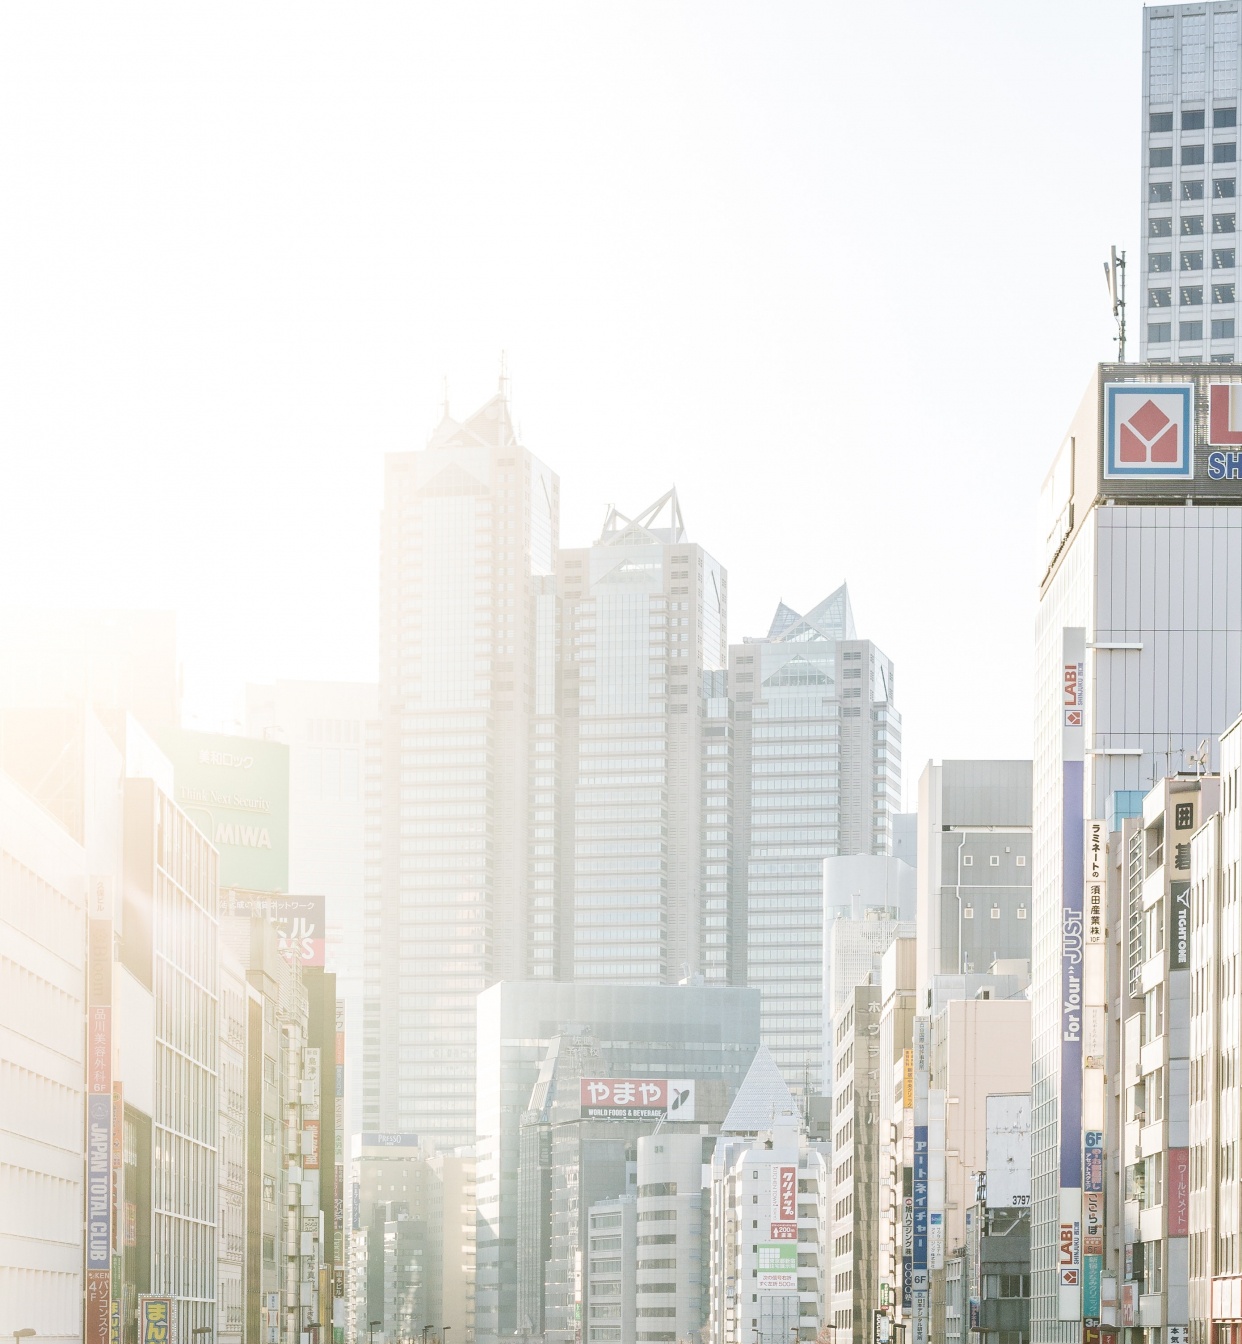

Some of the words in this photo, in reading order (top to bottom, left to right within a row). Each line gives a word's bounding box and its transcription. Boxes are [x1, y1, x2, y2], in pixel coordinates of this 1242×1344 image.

[1064, 665, 1077, 706] LABI
[181, 785, 208, 802] Think
[210, 789, 232, 805] Next
[234, 794, 271, 812] Security
[215, 822, 272, 849] MIWA
[1091, 824, 1101, 878] ラミネートの
[1063, 907, 1082, 964] JUST
[1064, 975, 1080, 1014] Your
[94, 1008, 106, 1082] 品川美容外科
[1064, 1014, 1080, 1042] For
[93, 1084, 106, 1092] 6F
[587, 1082, 662, 1105] やまや
[588, 1108, 607, 1116] WORLD
[608, 1109, 627, 1117] FOODS
[633, 1109, 662, 1117] BEVERAGE
[90, 1123, 108, 1173] JAPAN
[1085, 1132, 1102, 1147] 6F
[90, 1175, 107, 1220] TOTAL
[782, 1172, 794, 1216] クリナップ
[915, 1141, 927, 1248] アートネイチャー
[1178, 1164, 1187, 1225] ワールドメイト
[90, 1221, 107, 1261] CLUB
[1060, 1224, 1073, 1265] LABI
[914, 1275, 926, 1284] 6F
[1085, 1319, 1099, 1328] 3F
